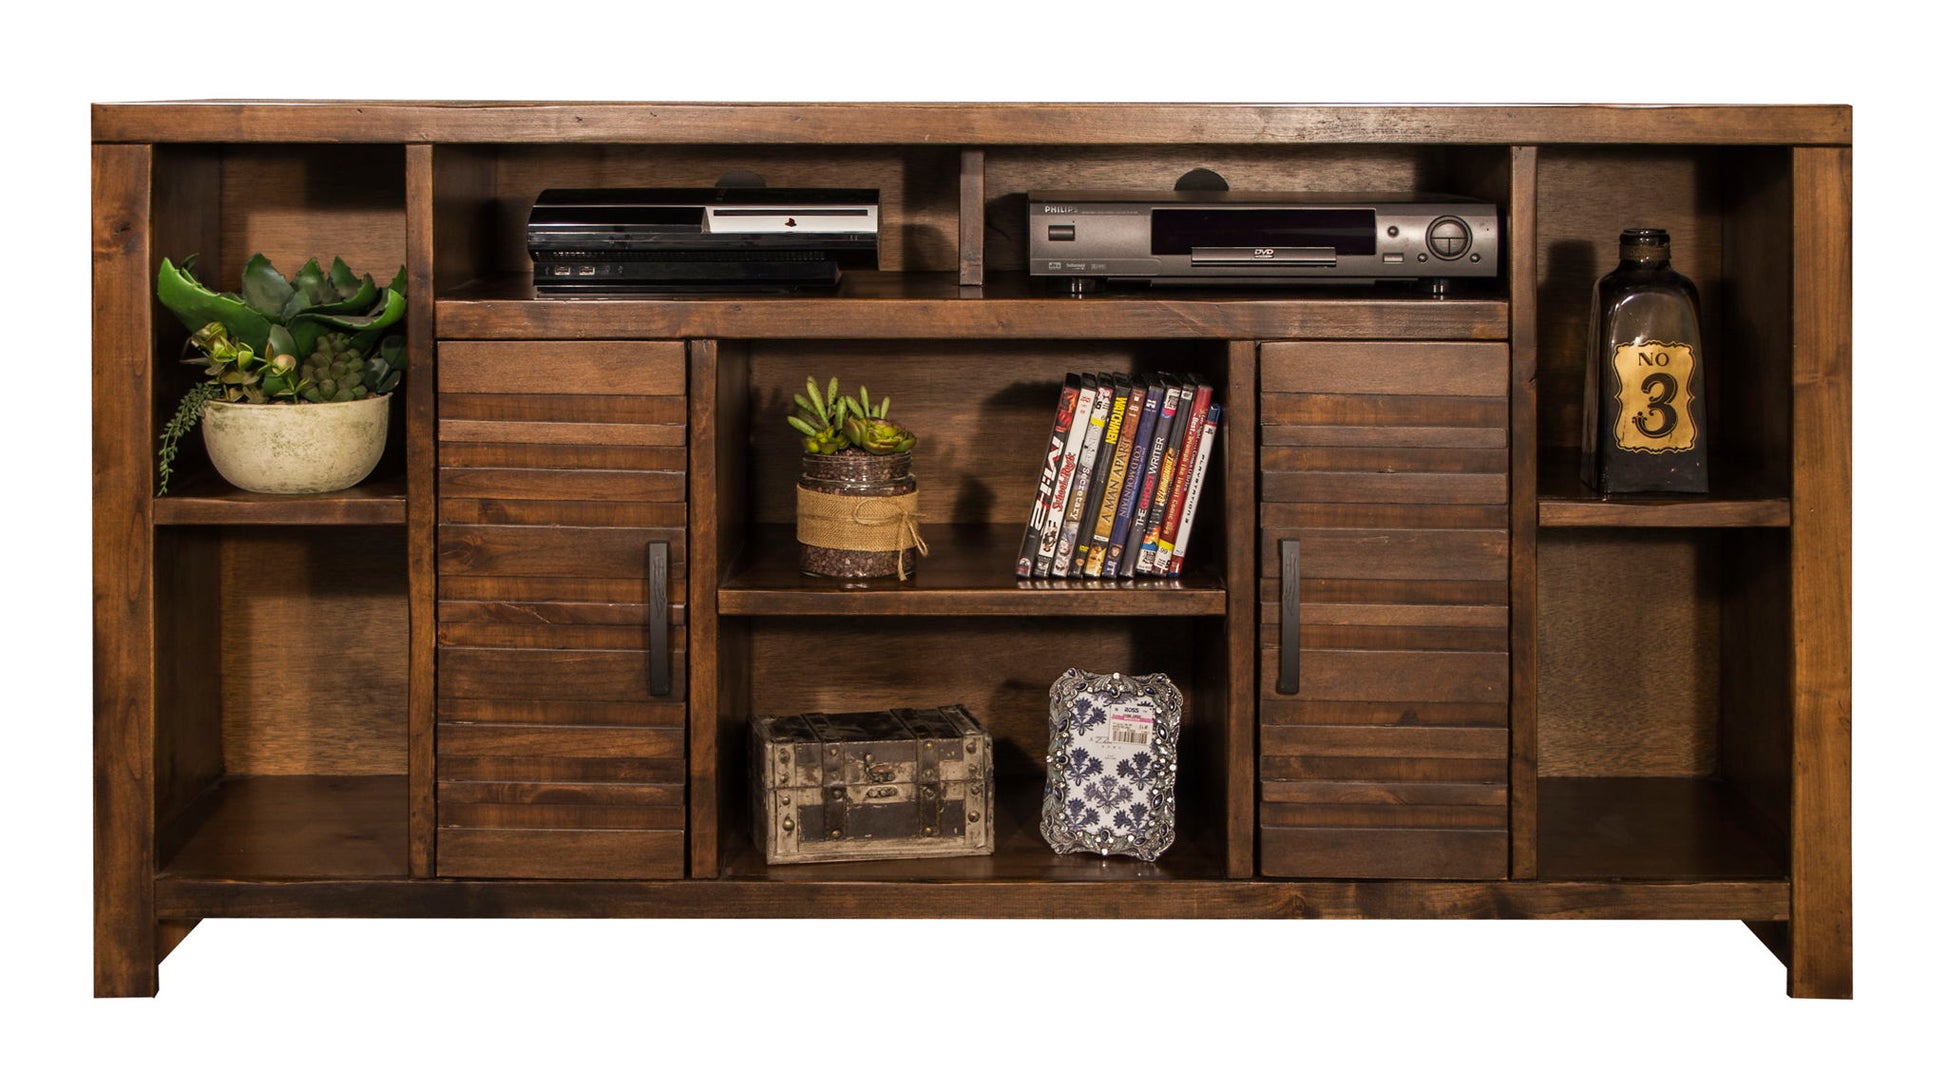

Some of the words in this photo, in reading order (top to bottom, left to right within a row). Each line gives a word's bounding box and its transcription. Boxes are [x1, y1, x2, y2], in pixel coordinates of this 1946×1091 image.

[1638, 352, 1670, 366] NO
[1105, 395, 1128, 445] WATCHMEN
[1632, 372, 1679, 438] 3
[1111, 437, 1131, 477] APART
[1131, 445, 1143, 468] COLD
[1148, 436, 1165, 475] WRITER
[1030, 436, 1064, 531] M:I-2
[1051, 480, 1069, 513] School
[1069, 467, 1090, 520] Secretary
[1103, 479, 1120, 510] MAN
[1118, 468, 1137, 517] MOUNTAIN
[1139, 474, 1156, 510] GHOST
[1101, 513, 1112, 522] A
[1135, 508, 1147, 528] THE
